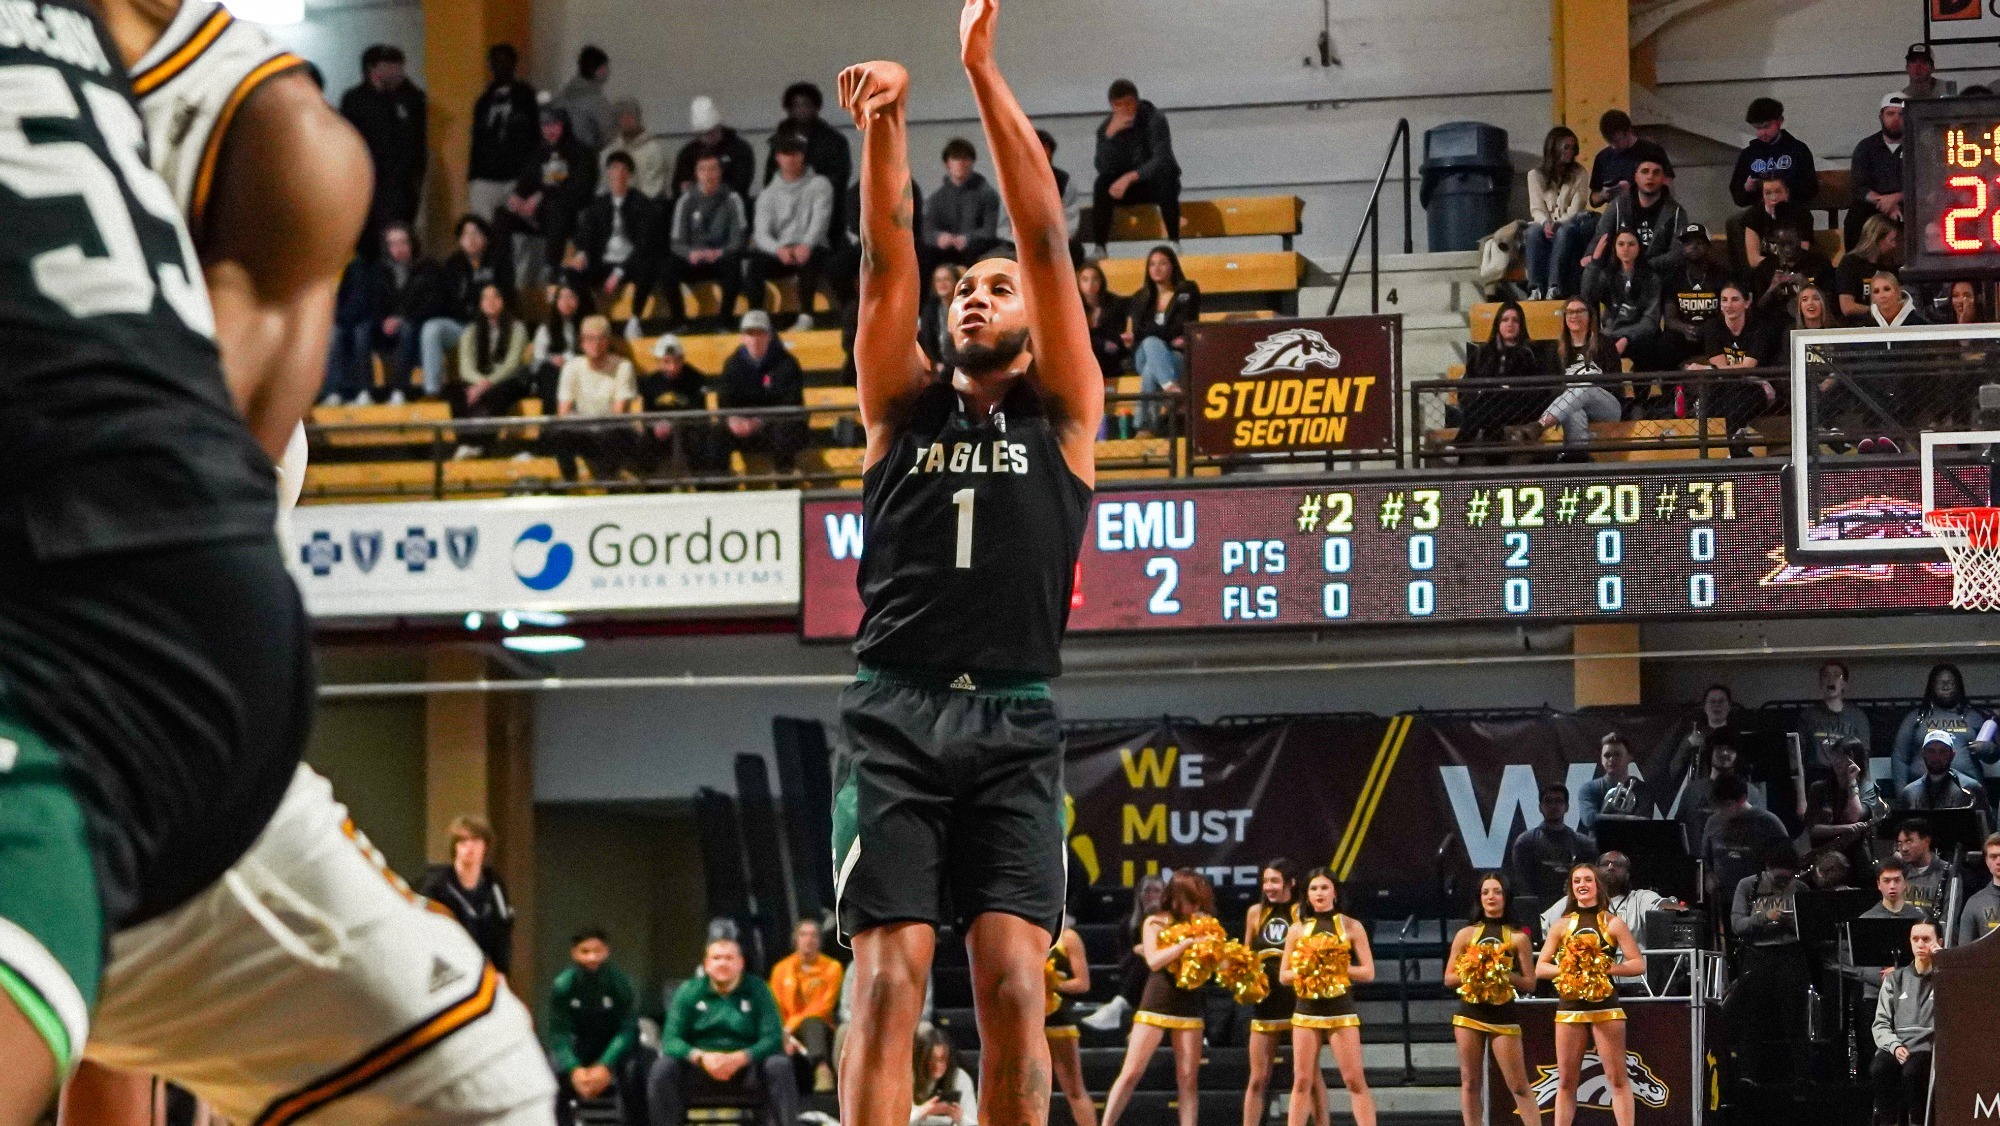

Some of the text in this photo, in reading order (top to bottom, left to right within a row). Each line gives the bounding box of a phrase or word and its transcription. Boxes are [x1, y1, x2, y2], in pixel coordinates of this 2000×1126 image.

[1386, 288, 1399, 306] 4
[1204, 376, 1376, 419] STUDENT
[1234, 416, 1347, 447] SECTION
[952, 488, 975, 569] 1
[1096, 500, 1197, 551] EMU
[1297, 481, 1737, 533] #2 #3 #12 #20 #31
[588, 516, 781, 567] Gordon
[1222, 526, 1716, 575] PTS 0 0 2 0 0
[1145, 556, 1182, 615] 2
[1222, 572, 1716, 620] FLS 0 0 0 0 0
[1120, 747, 1204, 788] WE
[1122, 804, 1253, 845] MUST
[1269, 923, 1286, 940] W
